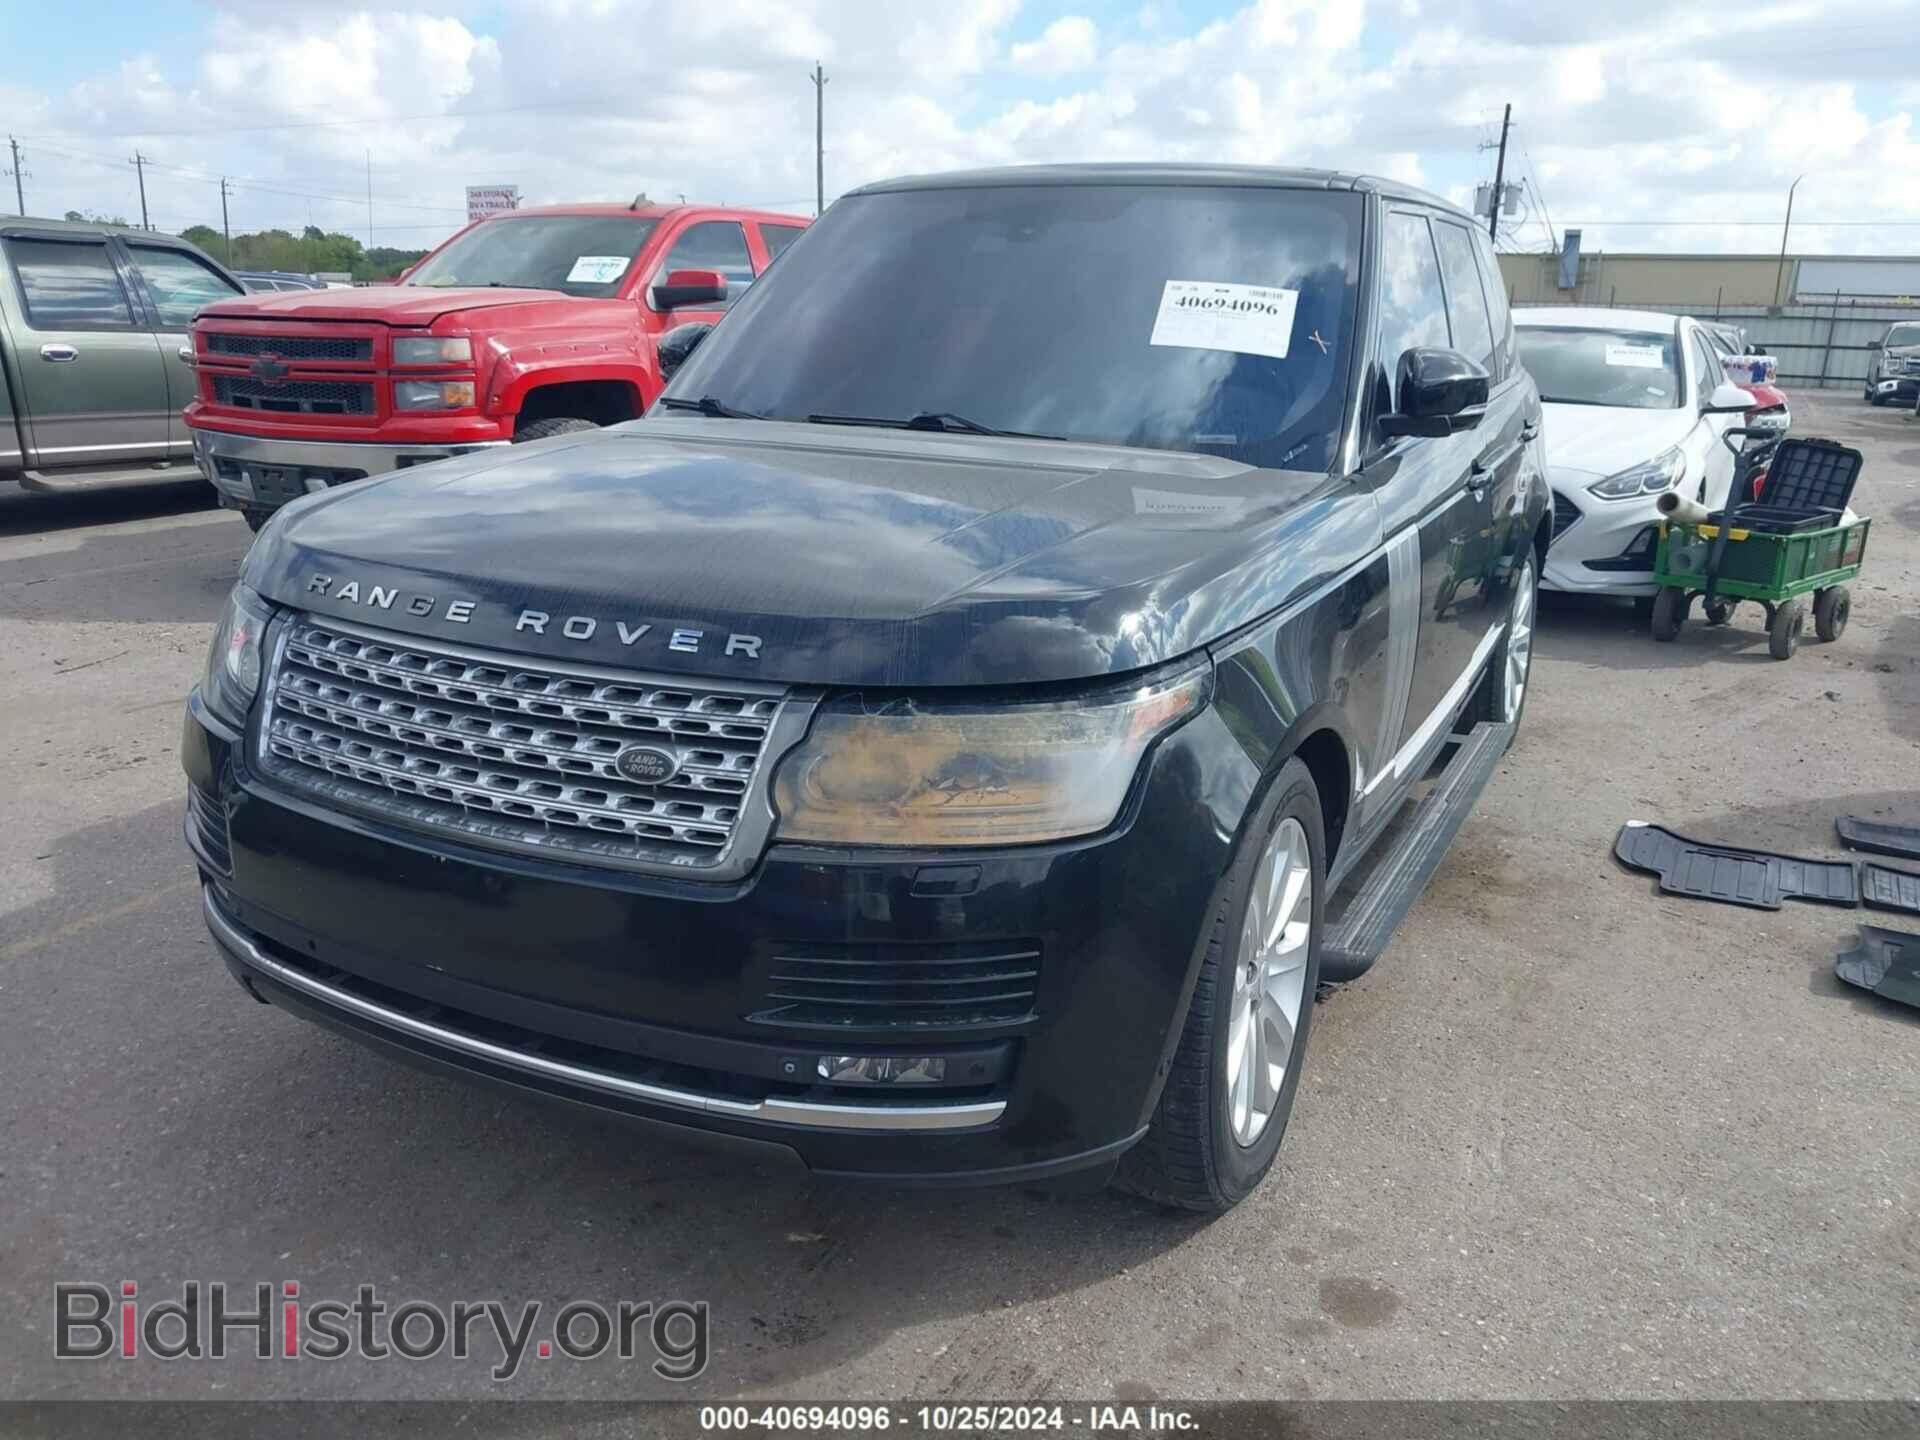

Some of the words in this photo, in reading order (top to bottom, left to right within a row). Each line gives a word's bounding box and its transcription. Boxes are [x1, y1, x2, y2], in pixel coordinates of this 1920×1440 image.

[1175, 296, 1278, 315] 40694096
[307, 573, 476, 623] RANGE
[515, 609, 763, 658] ROVER
[629, 754, 657, 765] LAND
[630, 763, 665, 776] ROVER
